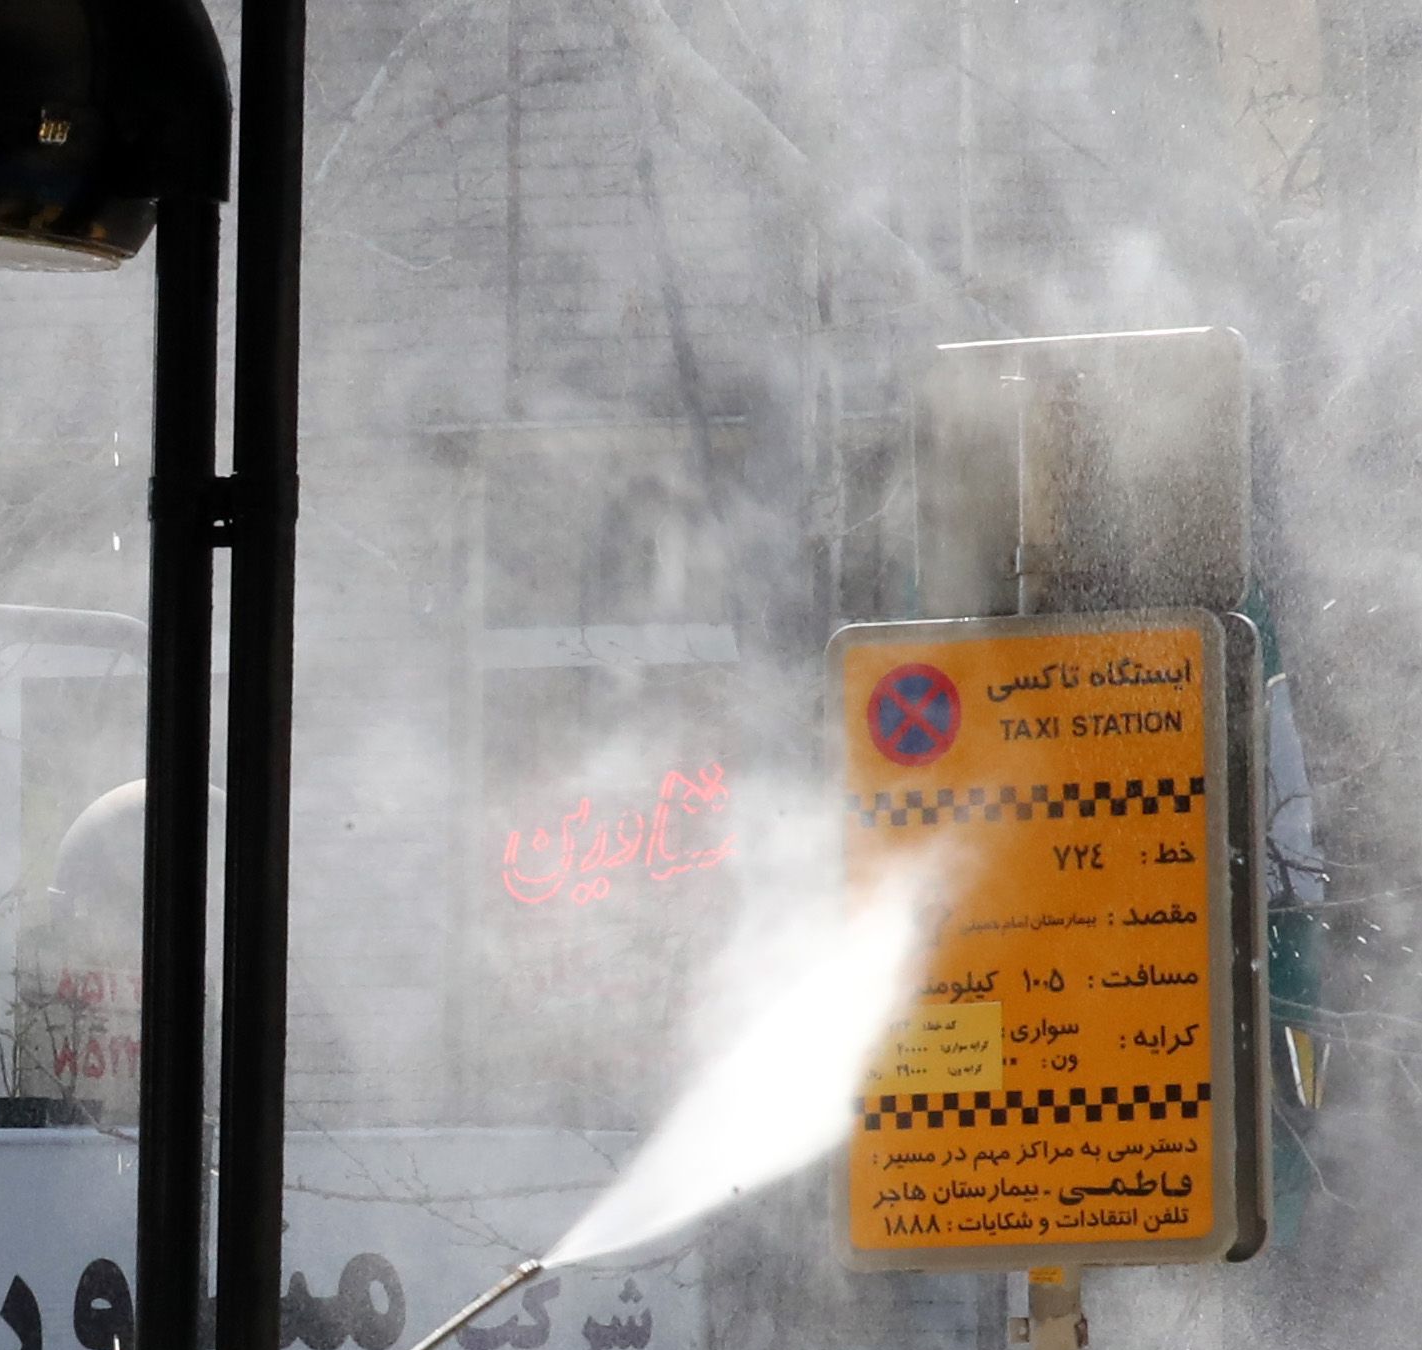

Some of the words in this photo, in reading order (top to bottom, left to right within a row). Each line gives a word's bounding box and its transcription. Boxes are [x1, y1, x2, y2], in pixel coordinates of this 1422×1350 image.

[986, 665, 1081, 703] تاکسی
[1089, 657, 1192, 692] ایستگاه
[1000, 716, 1060, 742] TAXI
[1071, 710, 1183, 738] STATION
[1154, 841, 1196, 864] خط
[1122, 903, 1198, 926] مقصد
[1101, 962, 1198, 989] مسافت
[1009, 1018, 1079, 1045] سواری
[1133, 1022, 1199, 1055] کرایه
[1050, 1053, 1078, 1073] ون
[883, 1153, 936, 1171] مسیر
[941, 1147, 968, 1167] در
[972, 1150, 1011, 1172] مهم
[1016, 1141, 1075, 1166] مراکز
[1081, 1141, 1101, 1164] به
[1106, 1137, 1198, 1164] دسترسی
[873, 1182, 927, 1209] هاجر
[932, 1177, 1039, 1205] بیمارستان
[1058, 1169, 1193, 1206] فاطمی
[883, 1213, 941, 1237] ۱۸۸۸
[958, 1210, 1033, 1236] شکایات
[1039, 1218, 1050, 1236] و
[1056, 1207, 1138, 1231] انتقادات
[1143, 1206, 1189, 1233] تلفن
